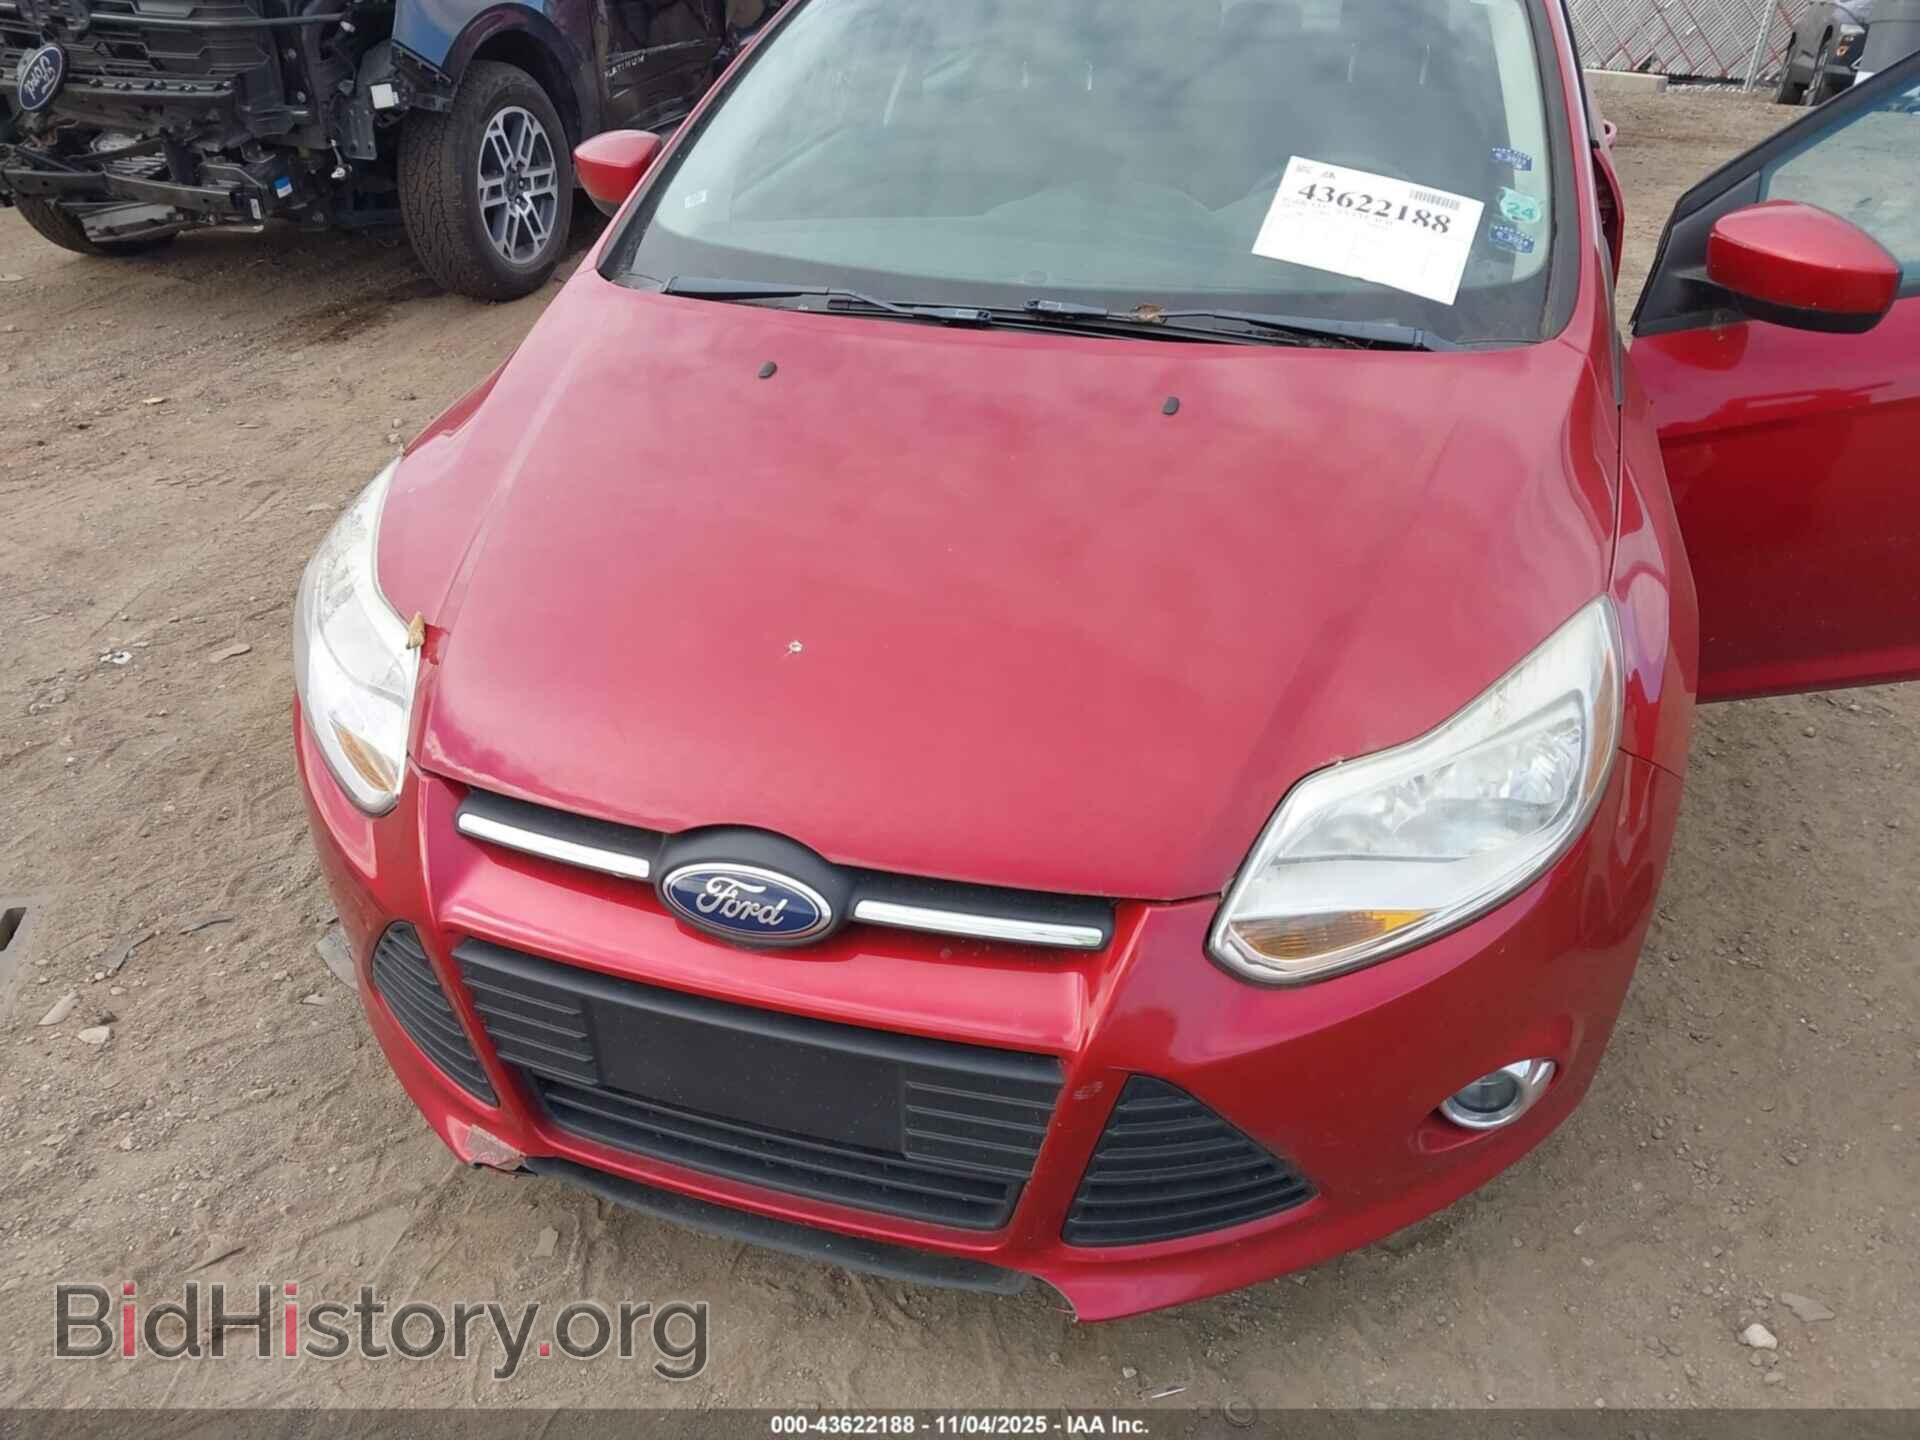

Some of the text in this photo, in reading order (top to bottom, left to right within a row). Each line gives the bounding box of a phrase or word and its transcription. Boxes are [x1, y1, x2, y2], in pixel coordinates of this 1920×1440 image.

[24, 55, 56, 100] Ford
[1298, 183, 1451, 233] 43622188
[696, 876, 788, 926] Ford
